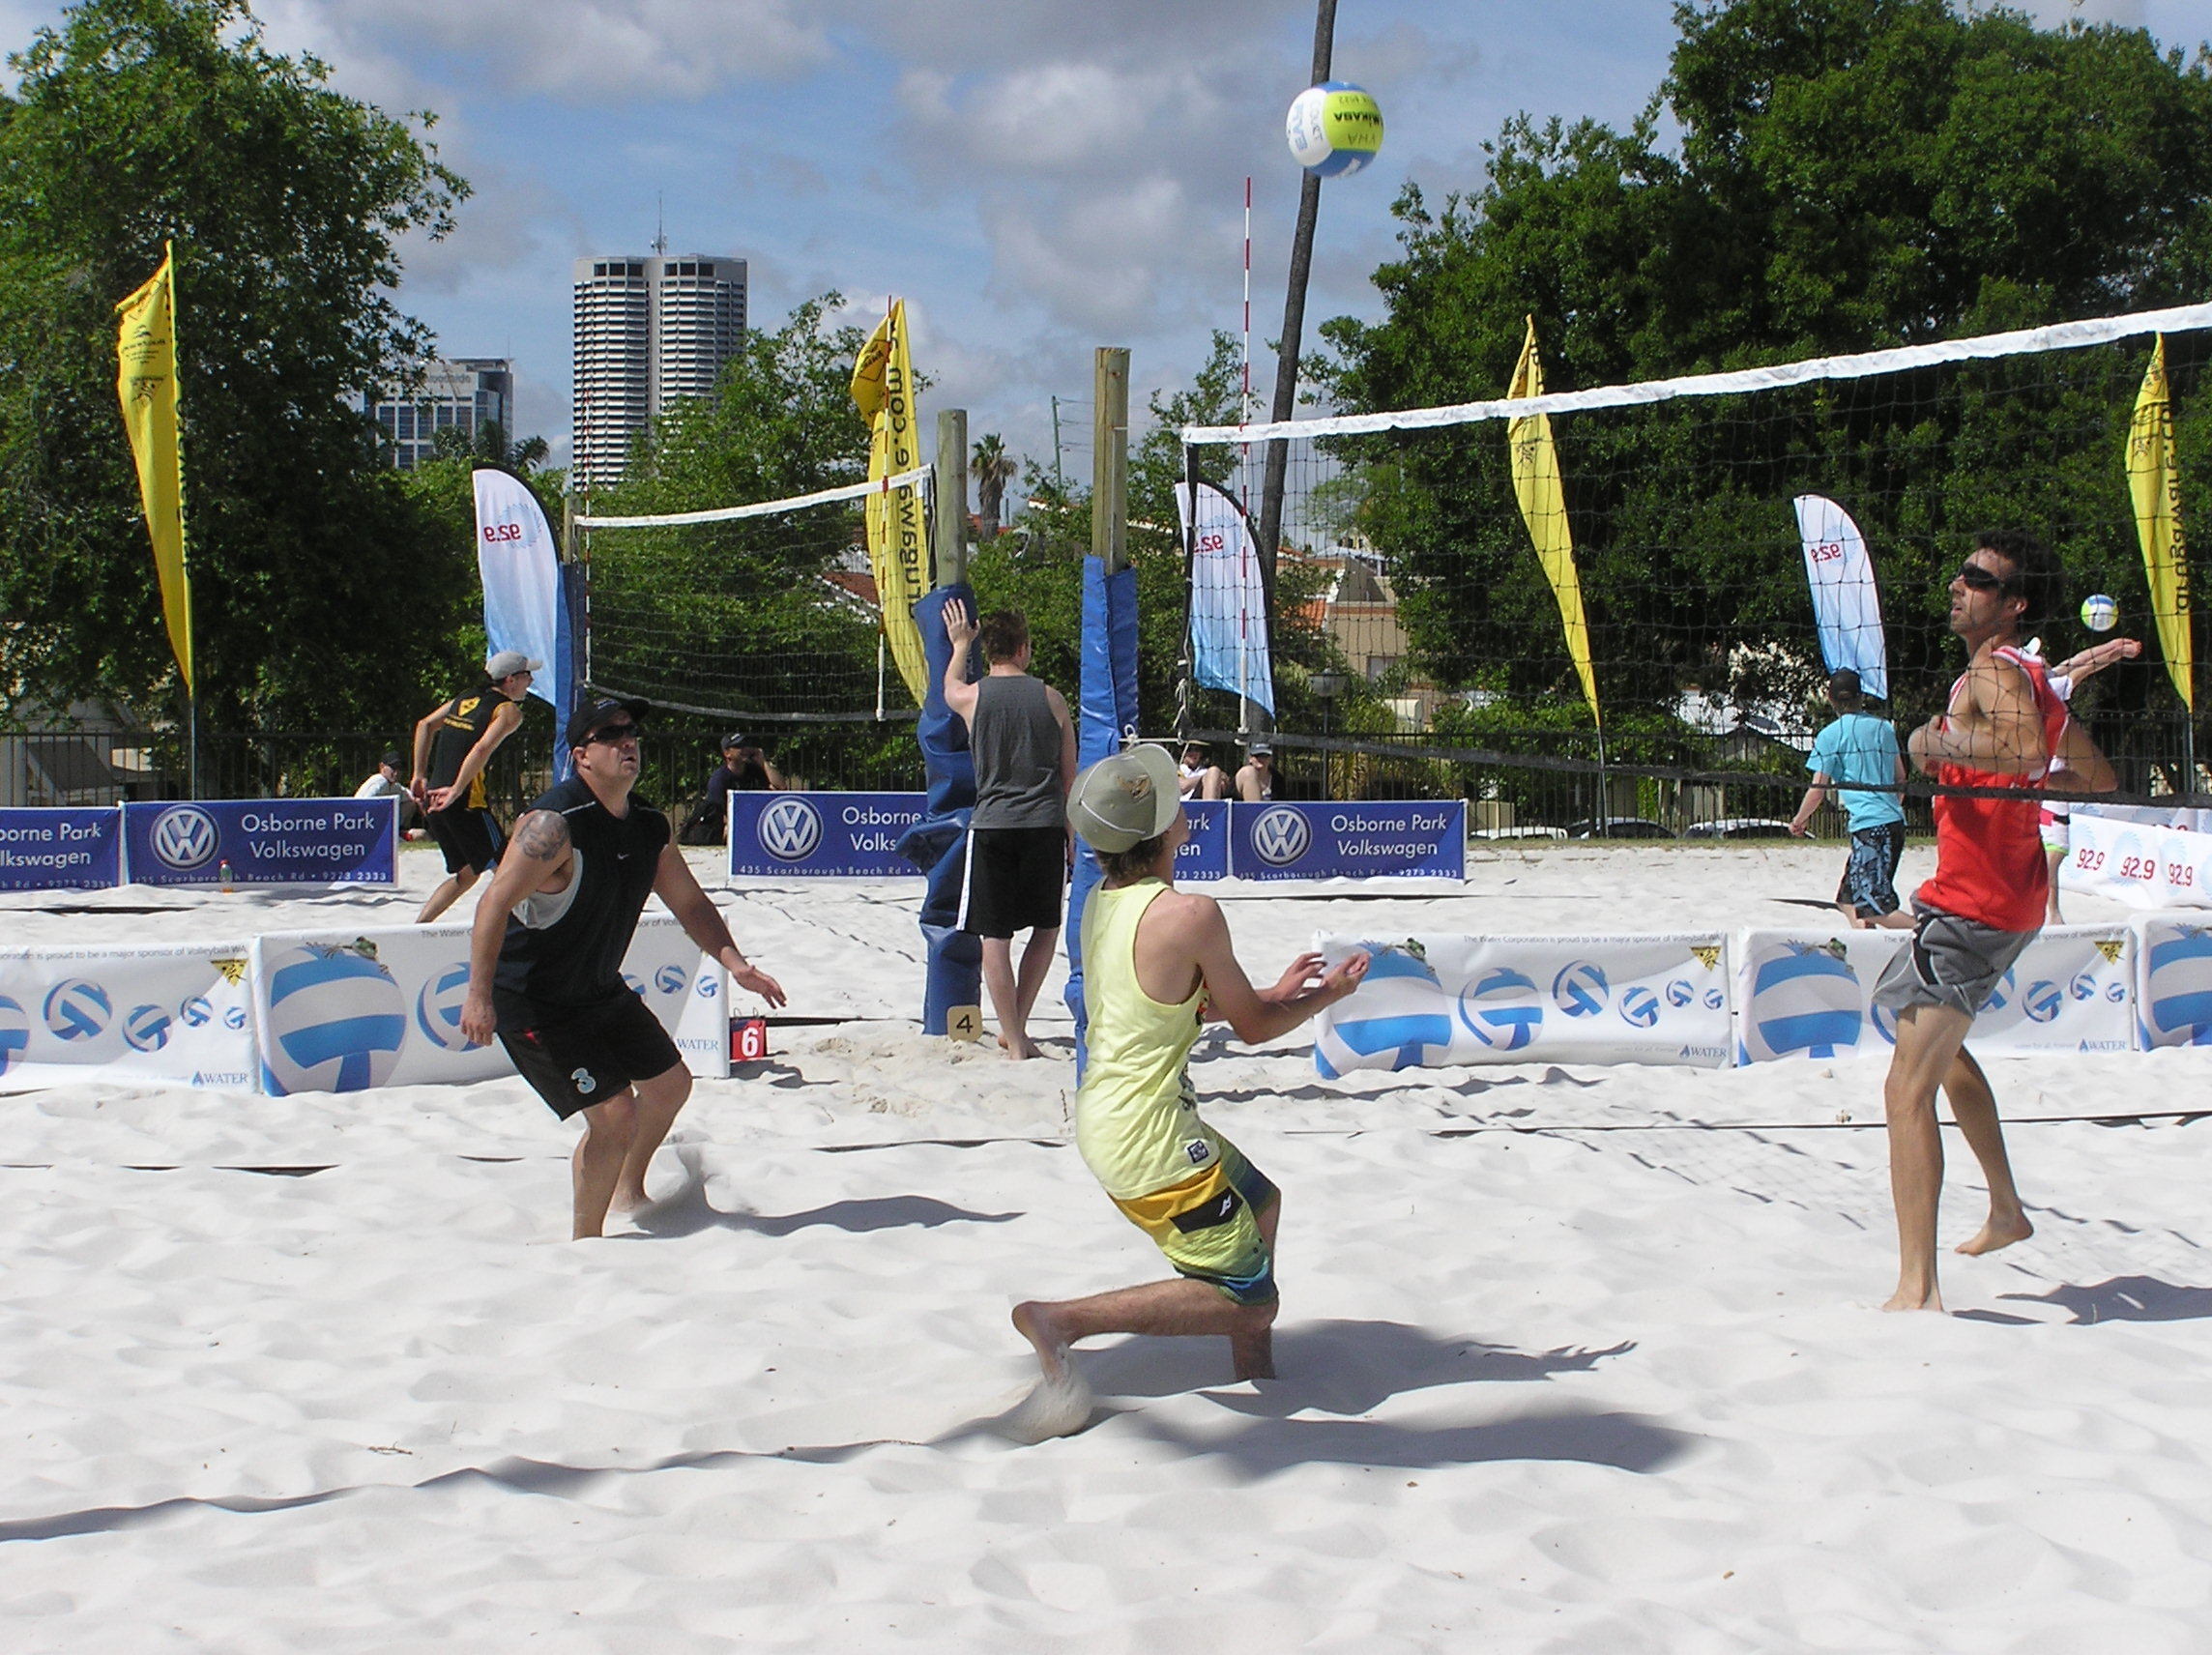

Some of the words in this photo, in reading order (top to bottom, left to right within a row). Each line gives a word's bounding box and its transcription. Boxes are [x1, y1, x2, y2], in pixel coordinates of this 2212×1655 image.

[242, 813, 327, 833] Osborne
[334, 812, 374, 830] Park
[842, 806, 922, 826] Osborne
[1331, 814, 1406, 832] Osborne
[1412, 813, 1446, 831] Park
[60, 822, 102, 841] Park
[249, 841, 365, 859] Volkswagen
[1337, 839, 1438, 859] Volkswagen
[2077, 848, 2106, 871] 92.9
[2120, 857, 2156, 880] 92.9
[767, 866, 843, 876] Scarborough
[848, 866, 883, 875] Beach
[888, 866, 902, 875] Rd
[2168, 863, 2193, 886] 92.9
[955, 1013, 974, 1033] 4
[677, 1037, 719, 1051] WATER
[741, 1027, 759, 1057] 6
[1691, 1046, 1727, 1058] WATER
[2088, 1040, 2126, 1051] WATER
[203, 1072, 248, 1084] WATER
[570, 1067, 597, 1094] 3
